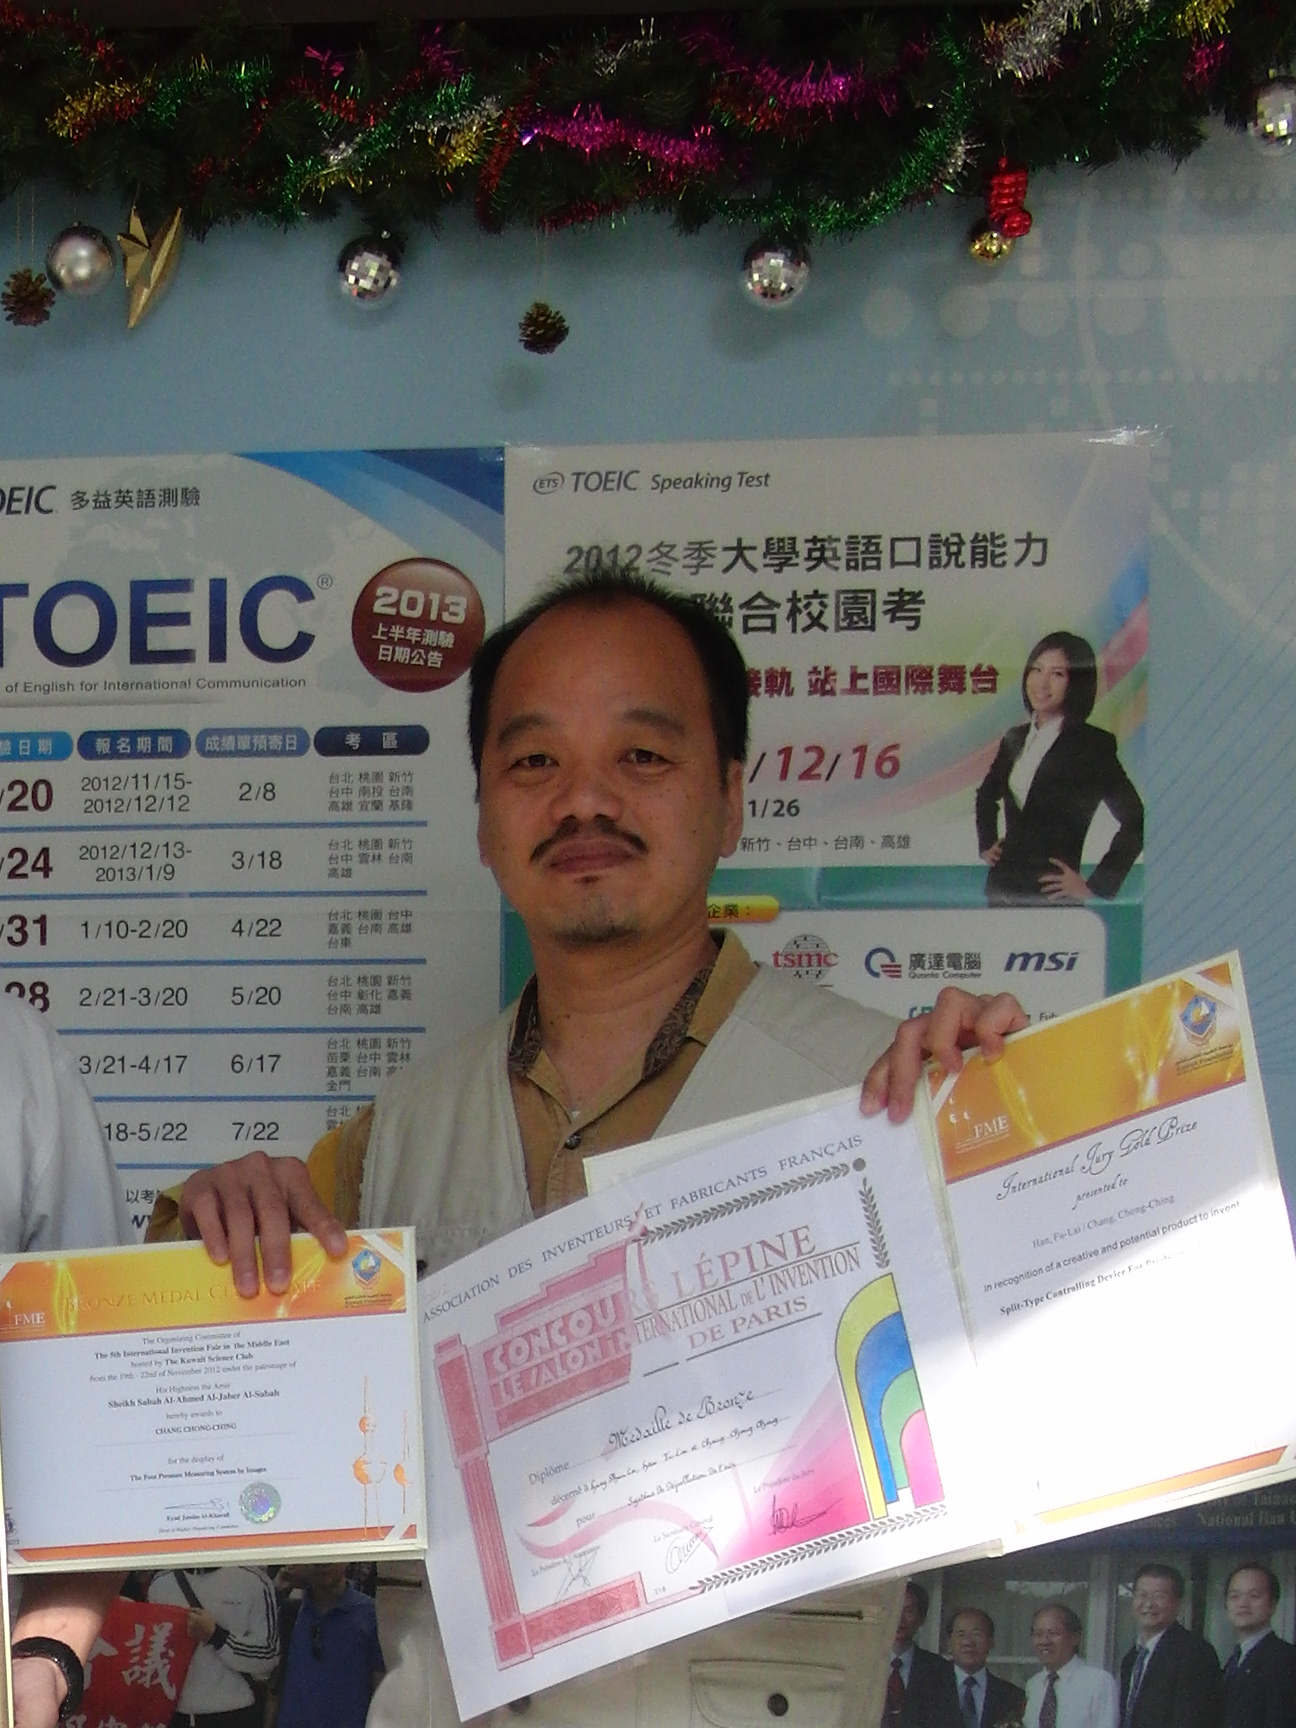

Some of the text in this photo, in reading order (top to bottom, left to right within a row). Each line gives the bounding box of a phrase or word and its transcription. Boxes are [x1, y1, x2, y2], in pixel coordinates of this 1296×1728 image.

[539, 470, 771, 494] ETS TOEIC Speaking Test
[70, 486, 201, 511] 多益英語測驗
[373, 586, 468, 626] 2013
[371, 622, 455, 650] 上半年測驗
[377, 643, 444, 669] 日期公告
[5, 681, 19, 694] of
[24, 680, 76, 696] English
[80, 680, 99, 692] for
[103, 678, 192, 692] International
[196, 677, 307, 690] Communication
[807, 662, 1000, 698] 站上國際舞台
[95, 734, 174, 754] 報名期間
[205, 734, 298, 752] 成績單預寄日
[81, 773, 193, 792] 2012/11/15-
[238, 783, 276, 802] 2/8
[83, 795, 190, 814] 2012/12/12
[78, 841, 192, 861] 2012/12/13-
[231, 851, 283, 871] 3/18
[95, 863, 176, 882] 2013/1/9
[80, 919, 189, 940] 1/10-2/20
[231, 918, 283, 939] 4/22
[772, 949, 840, 969] tsmc
[1004, 950, 1080, 972] msi
[79, 986, 189, 1007] 2/21-3/20
[231, 986, 282, 1006] 5/20
[78, 1054, 188, 1075] 3/21-4/17
[230, 1054, 282, 1074] 6/17
[231, 1121, 280, 1142] 7/22
[995, 1115, 1199, 1200] International Jury Gold Prize
[1071, 1174, 1128, 1211] presented to
[423, 1134, 863, 1323] ASSOCIATION DES INVENTEURS ET FABRICANTS FRANÇAIS
[672, 1224, 817, 1299] LÉPINE
[994, 1266, 1044, 1291] recognition
[1045, 1261, 1054, 1272] of
[1055, 1260, 1062, 1269] a
[1100, 1240, 1118, 1254] and
[1120, 1228, 1161, 1250] potential
[1162, 1214, 1198, 1236] product
[1199, 1211, 1209, 1221] to
[142, 1290, 201, 1306] MEDAL
[1000, 1295, 1045, 1316] Split-Type
[1045, 1278, 1096, 1301] Controlling
[688, 1295, 809, 1350] DE PARIS
[528, 1461, 570, 1486] Diplôme
[575, 1511, 596, 1528] pour
